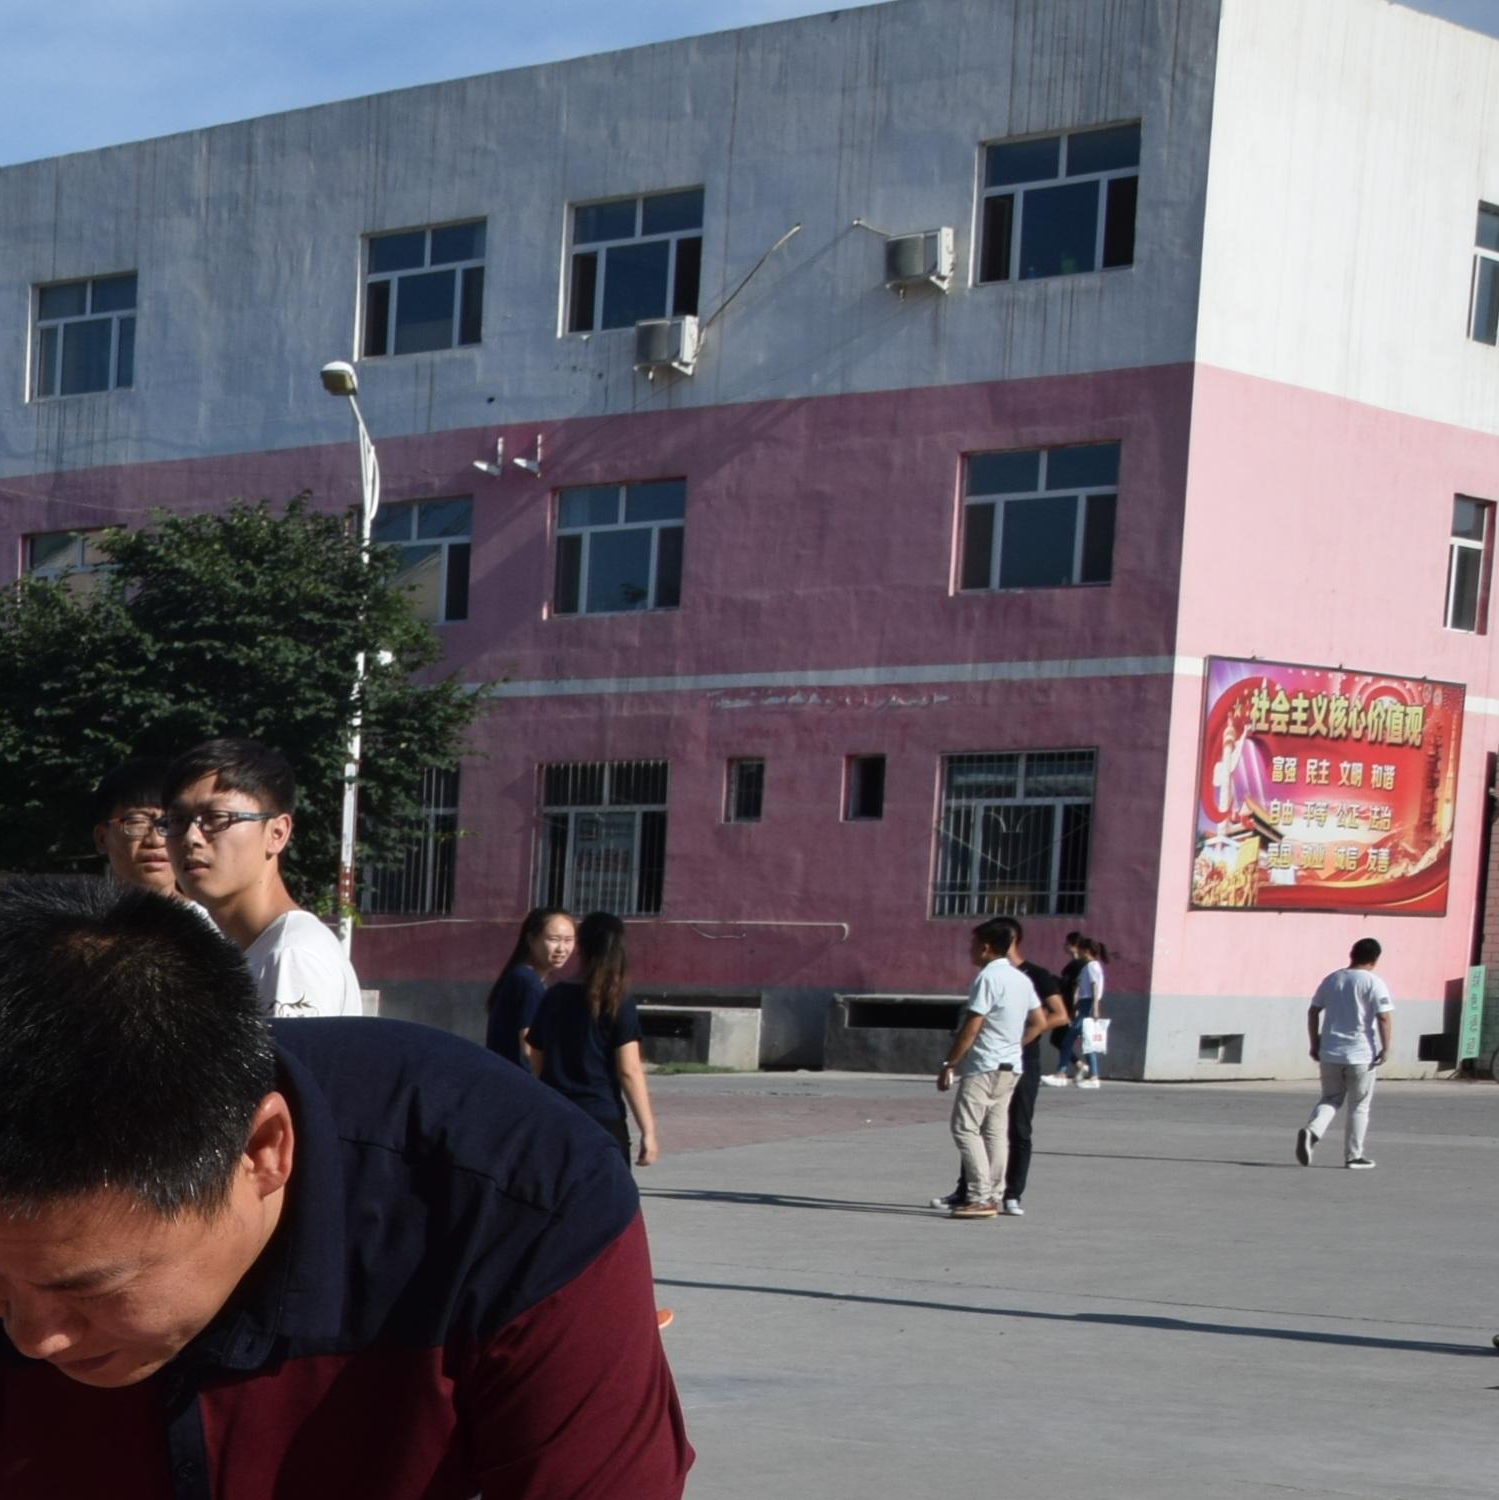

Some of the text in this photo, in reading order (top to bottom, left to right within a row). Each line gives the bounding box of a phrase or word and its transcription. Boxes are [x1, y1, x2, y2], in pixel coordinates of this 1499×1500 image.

[1250, 689, 1424, 747] 社会主义核心价值观
[1272, 756, 1395, 790] 富强 民主 文明 和谐
[1269, 799, 1392, 832] 自由 平等 公正 法治
[1366, 847, 1390, 873] 友善
